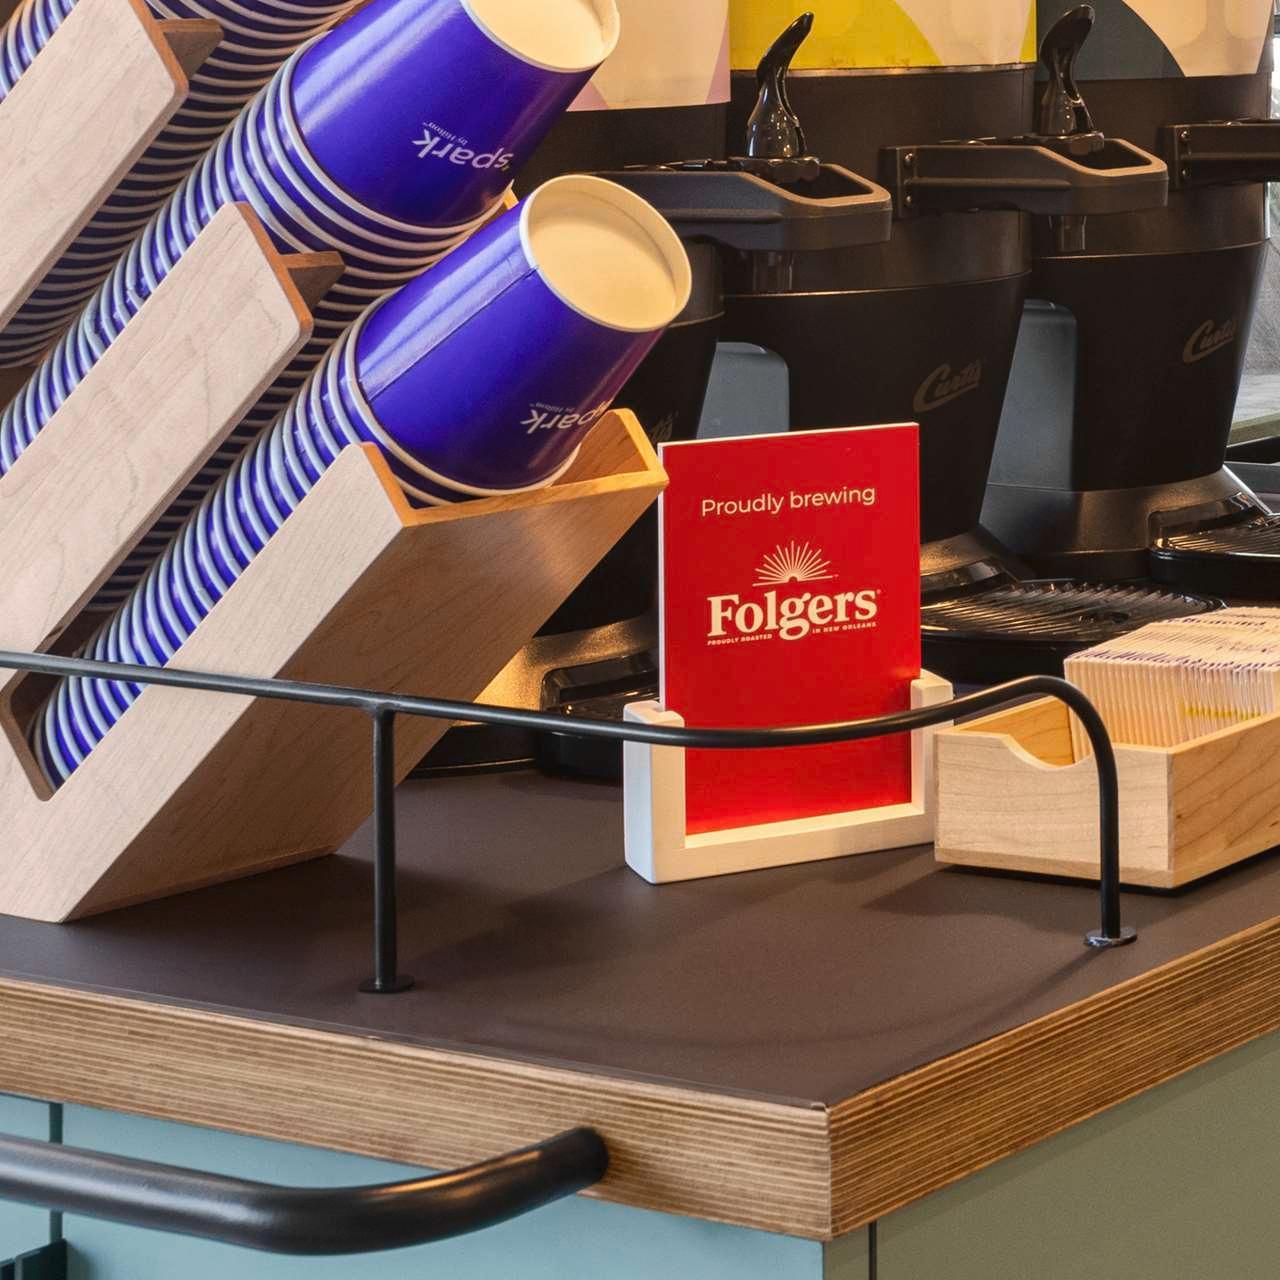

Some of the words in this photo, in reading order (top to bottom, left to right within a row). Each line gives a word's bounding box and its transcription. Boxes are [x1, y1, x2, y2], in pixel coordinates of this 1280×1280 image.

[411, 129, 514, 168] spark
[702, 492, 784, 516] Proudly
[789, 486, 876, 509] brewing
[707, 590, 878, 641] Folgers
[823, 624, 840, 633] NEW
[842, 621, 877, 631] ORLEANS
[707, 635, 739, 646] PROUDLY
[740, 633, 773, 642] ROASTED
